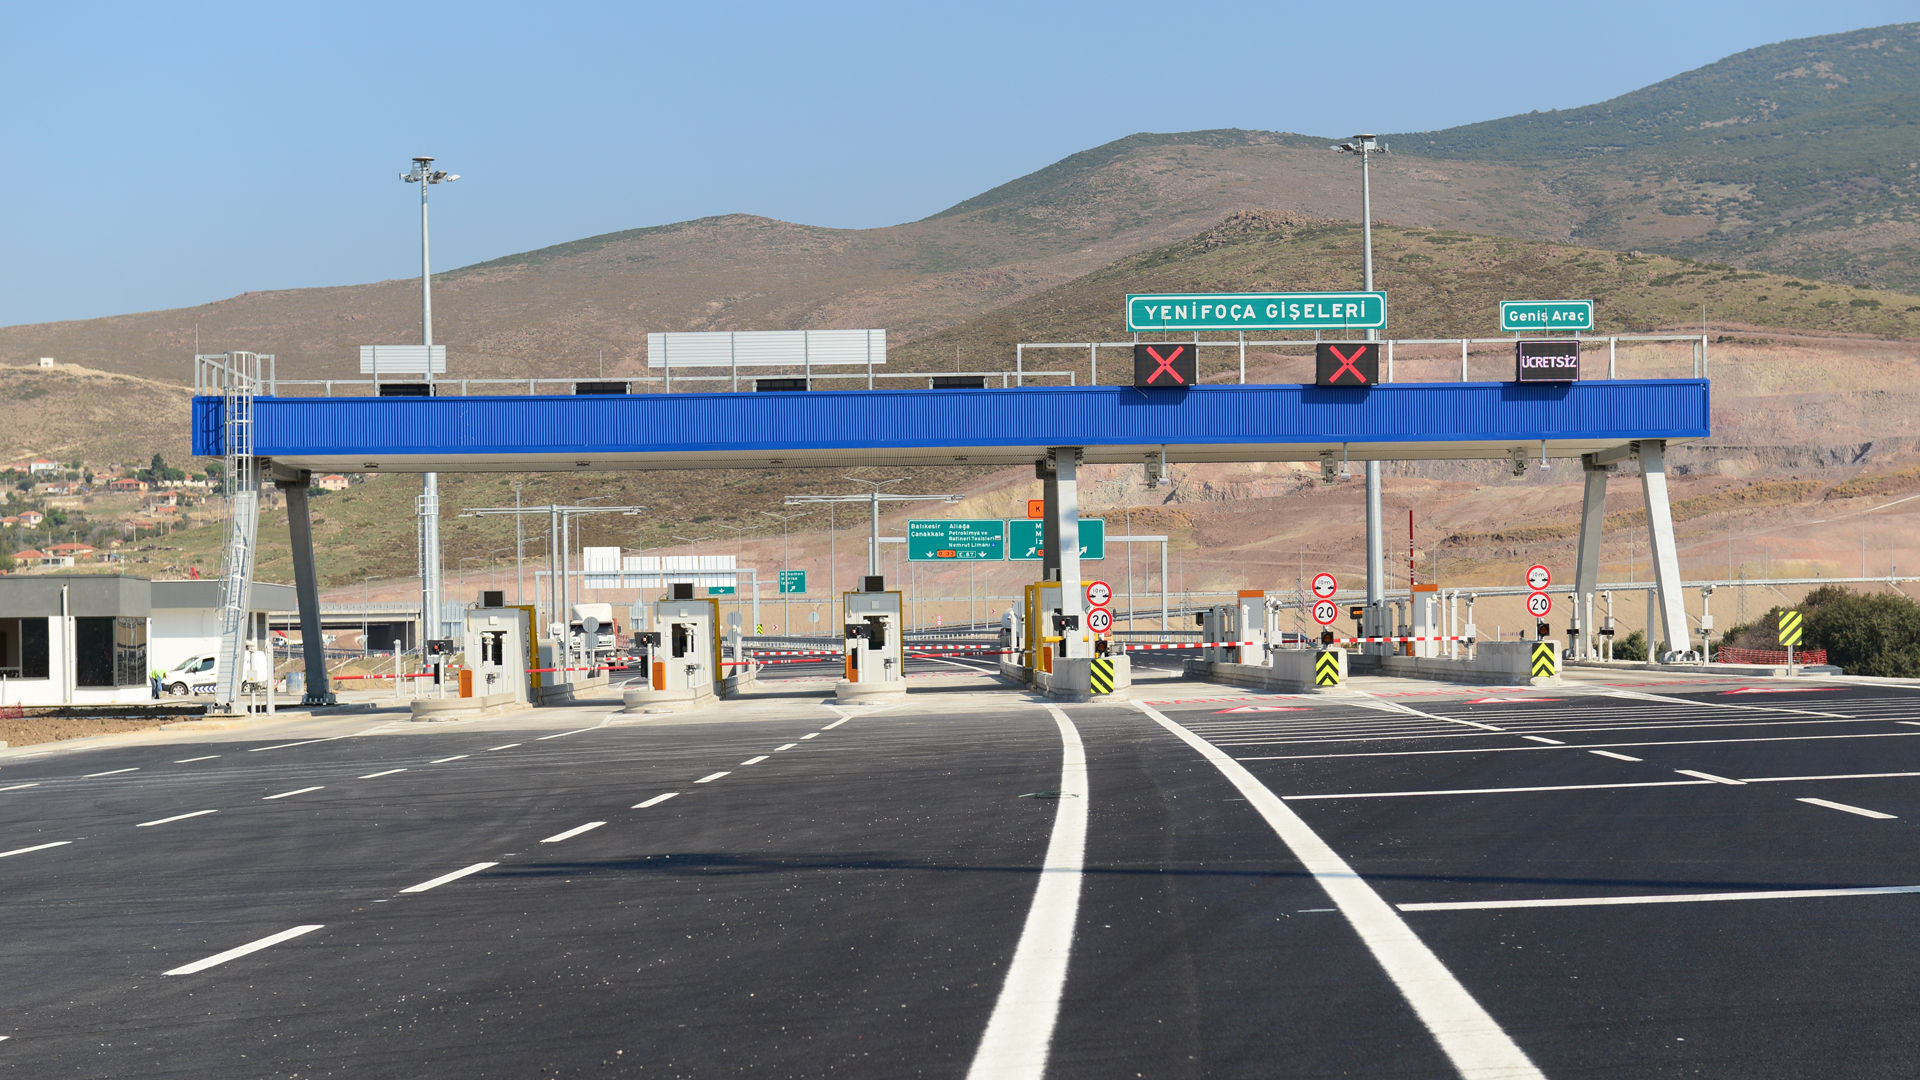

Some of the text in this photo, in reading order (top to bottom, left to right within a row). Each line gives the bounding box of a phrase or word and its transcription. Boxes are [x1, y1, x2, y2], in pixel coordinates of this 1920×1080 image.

[1144, 300, 1366, 321] YENİFOÇA GİŞELERİ
[1509, 310, 1585, 323] Geniş Araç
[1521, 354, 1577, 368] ÜCRETSİZ
[1532, 598, 1547, 610] 20
[1318, 606, 1333, 618] 20
[1093, 614, 1108, 626] 20
